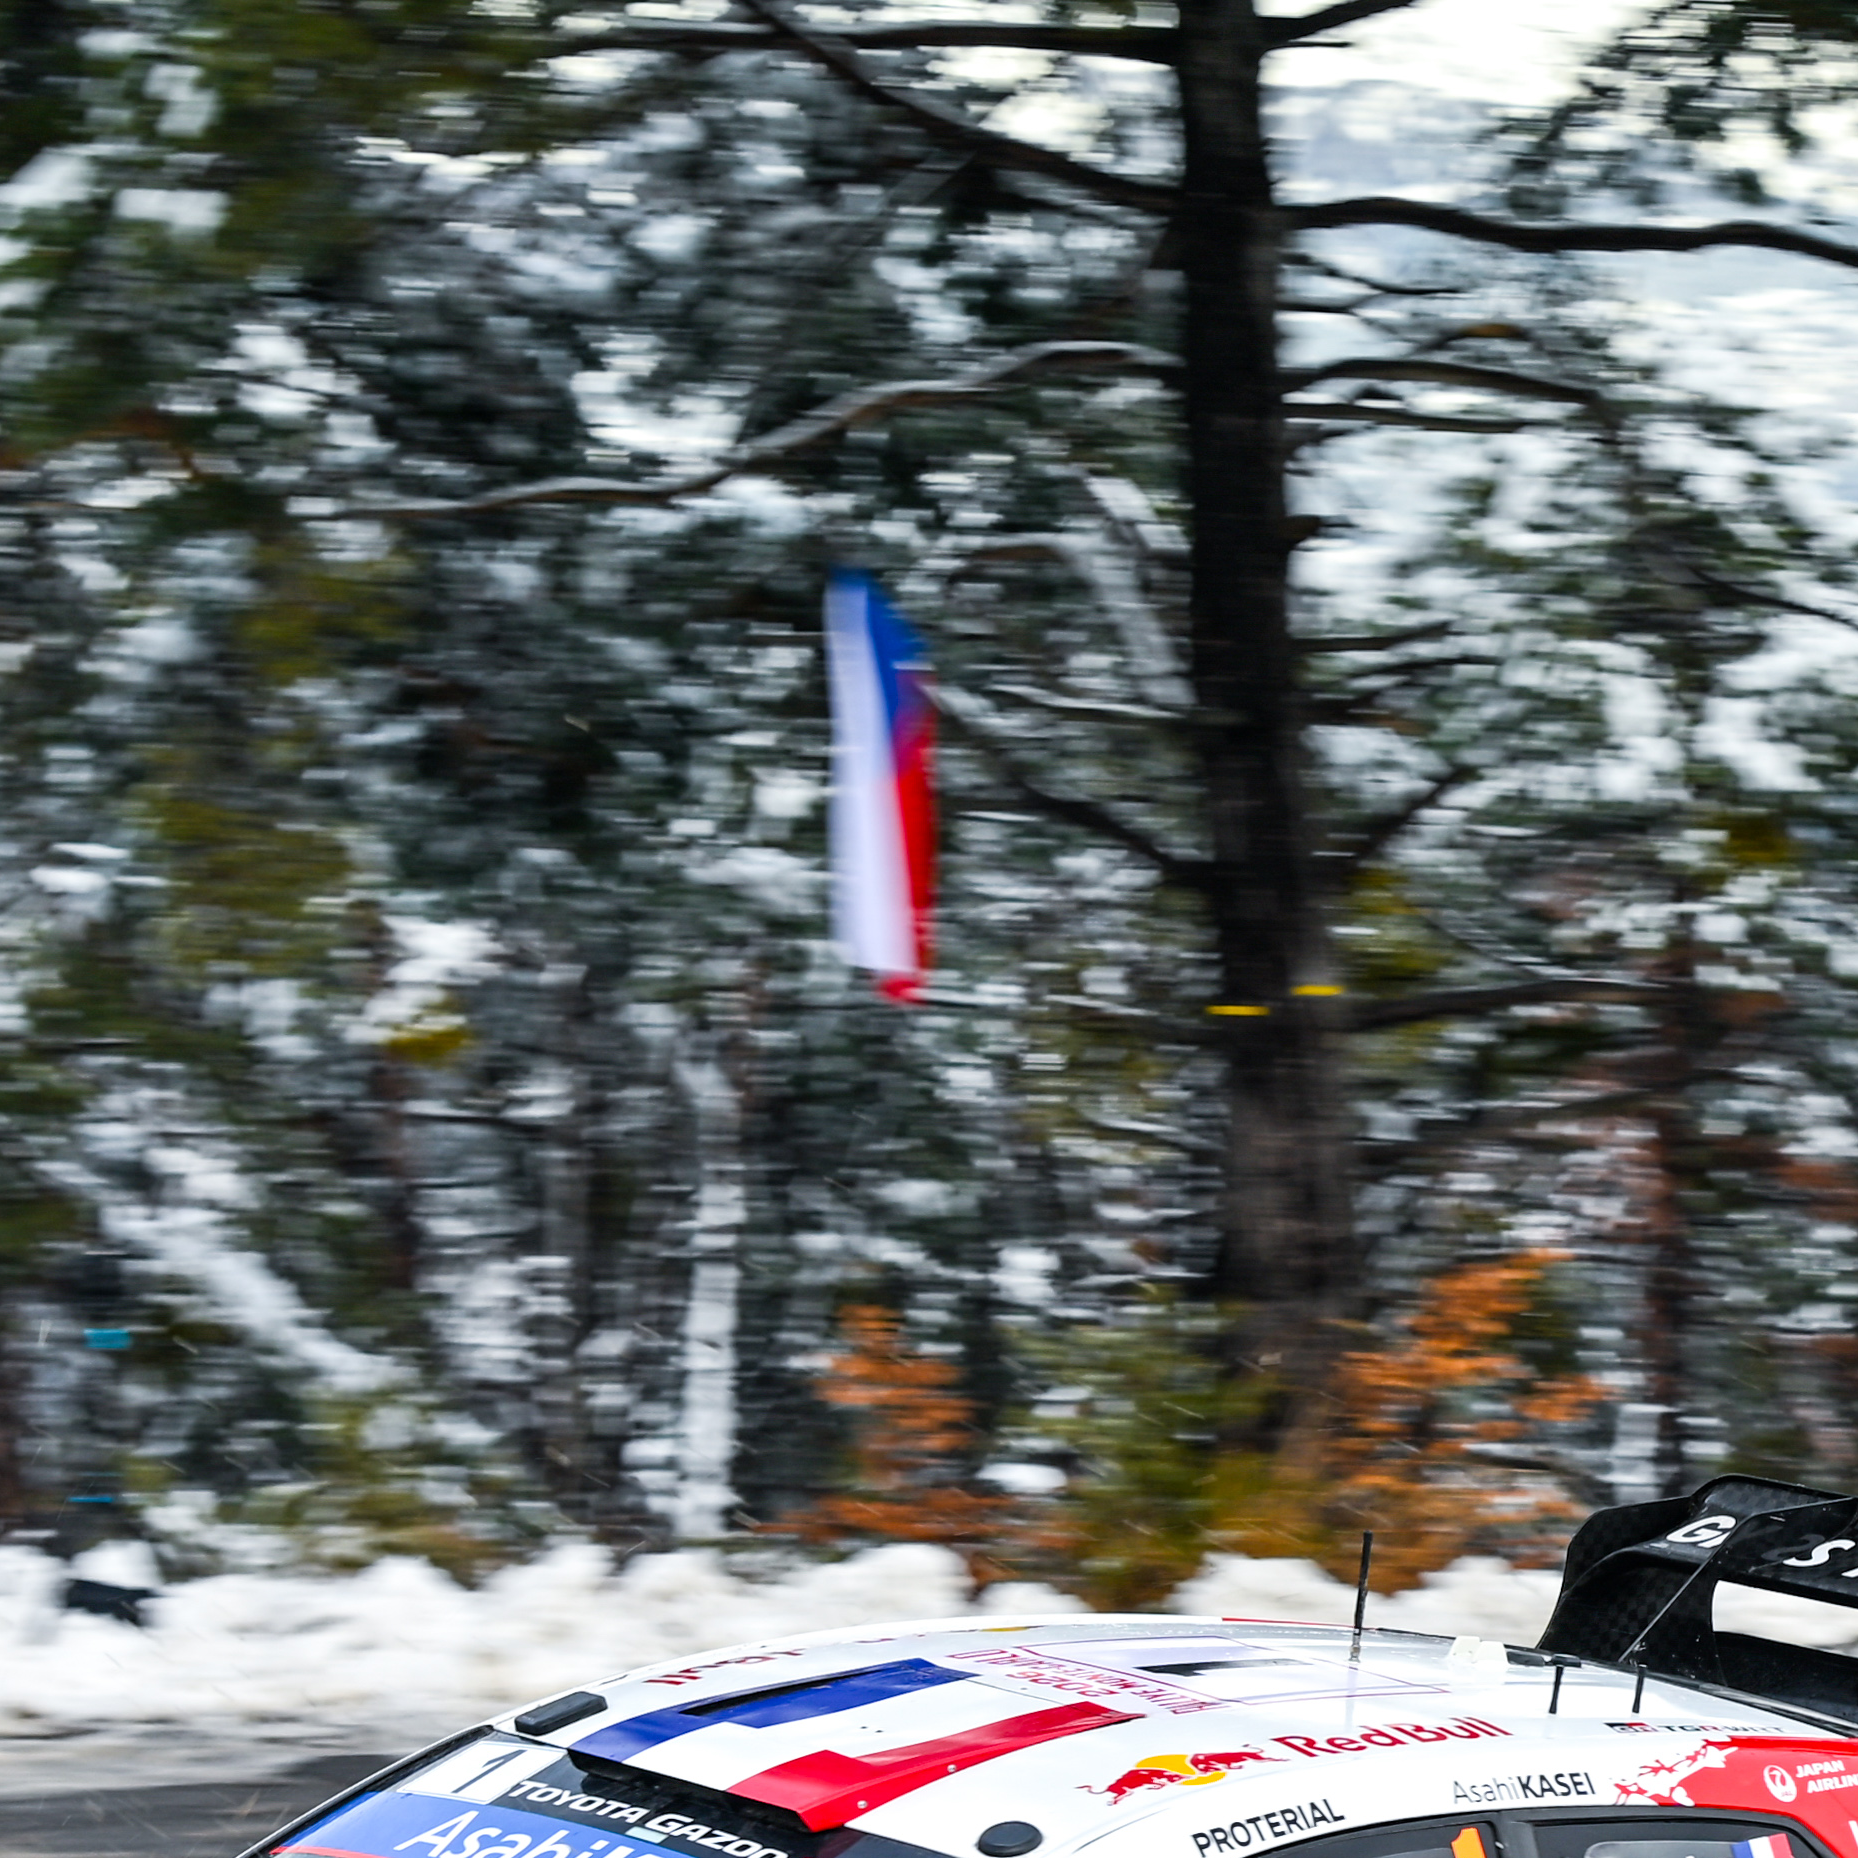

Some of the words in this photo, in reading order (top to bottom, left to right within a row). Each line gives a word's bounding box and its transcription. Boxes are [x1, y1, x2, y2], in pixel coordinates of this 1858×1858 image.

[453, 1749, 529, 1794] 1
[1795, 1760, 1845, 1779] JAPAN
[508, 1780, 650, 1823] TOYOTA
[1191, 1799, 1345, 1858] PROTERIAL
